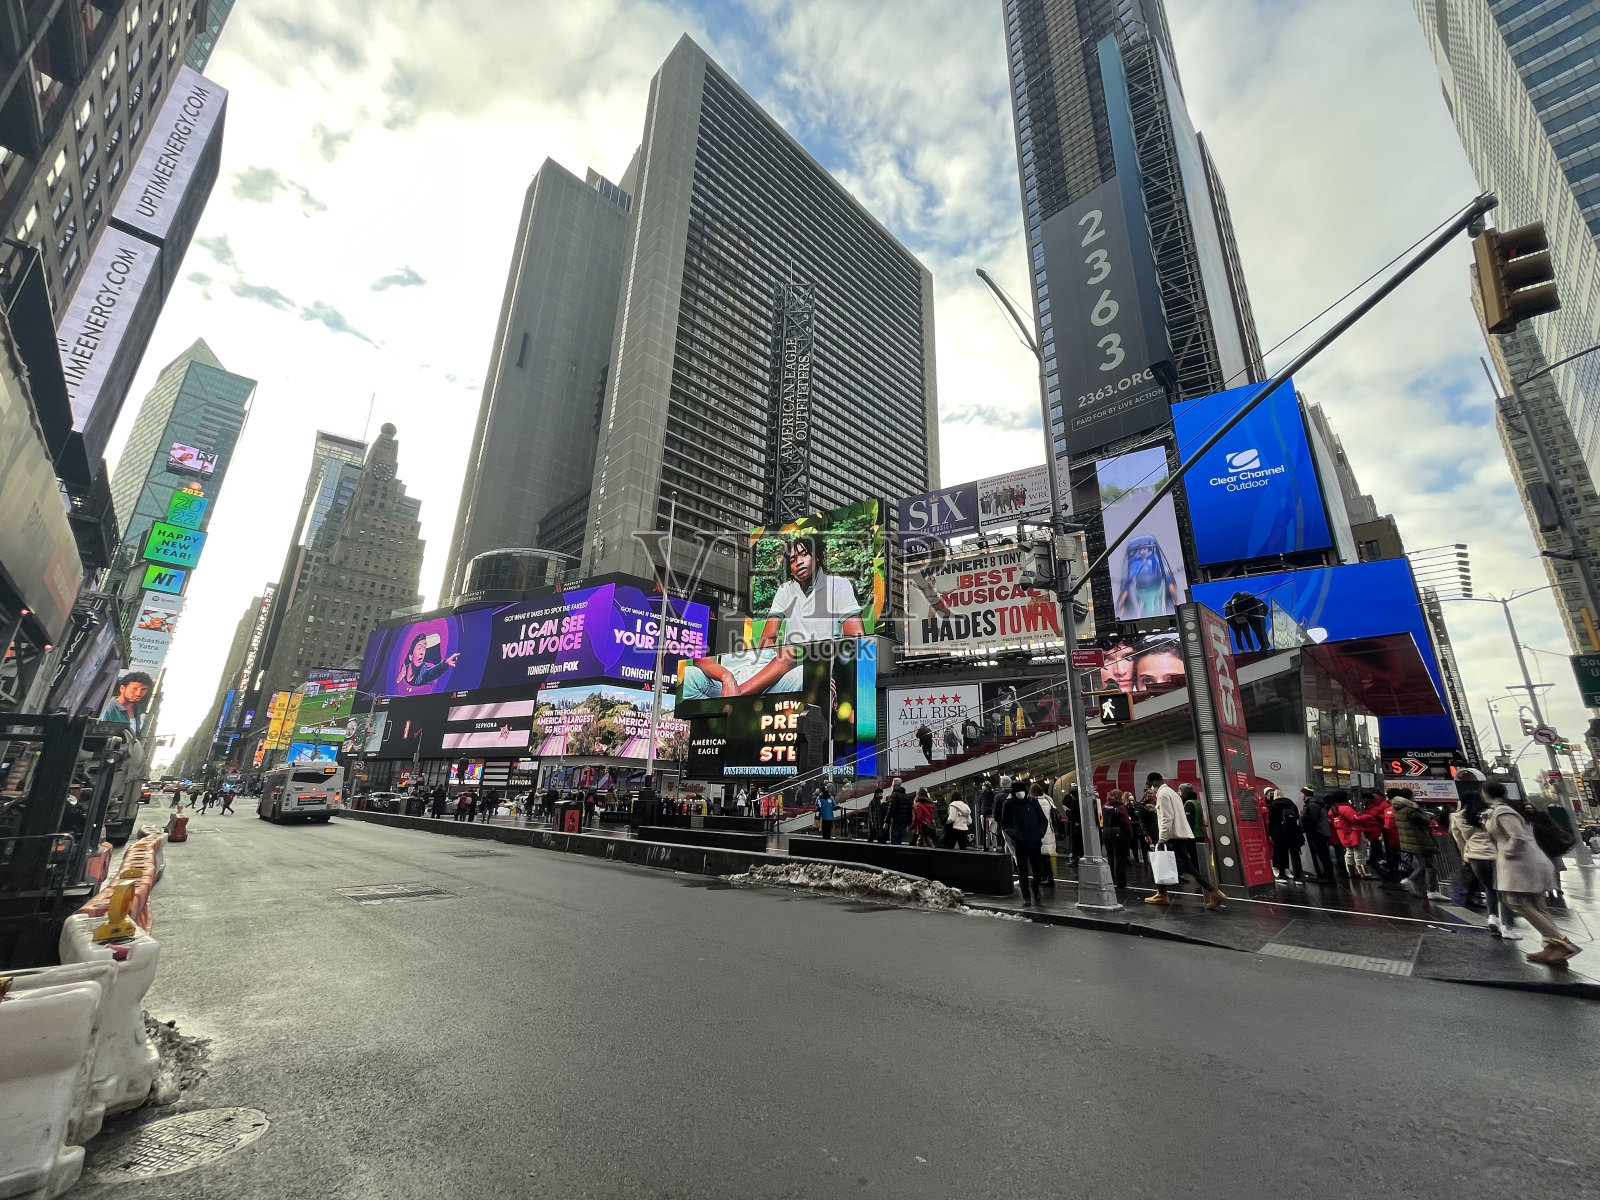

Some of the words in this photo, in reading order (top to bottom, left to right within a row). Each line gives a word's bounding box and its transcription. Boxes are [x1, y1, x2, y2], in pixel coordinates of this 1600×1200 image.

[136, 87, 210, 218] UPTIMEENERGY.COM
[784, 338, 797, 379] EAGLE
[796, 355, 810, 441] OUTFITTERS
[1076, 416, 1092, 426] PAID
[1093, 410, 1107, 420] FOR
[1108, 406, 1117, 414] BY
[1118, 401, 1133, 410] LIVE
[1134, 388, 1164, 404] ACTION
[781, 383, 795, 460] AMERICAN
[1210, 474, 1238, 486] Clear
[1239, 464, 1285, 481] Channel
[182, 487, 204, 497] 2022
[1226, 478, 1269, 492] Outdoor
[157, 529, 200, 544] HAPPY
[161, 539, 190, 551] NEW
[155, 546, 192, 560] YEAR!
[920, 557, 988, 578] WINNER!
[990, 556, 996, 568] 8
[999, 552, 1022, 566] TONY
[152, 572, 177, 587] NT
[959, 566, 1017, 589] BEST
[504, 615, 514, 623] GOT
[514, 613, 526, 621] WHAT
[531, 610, 544, 618] TAKES
[550, 606, 562, 614] SPOT
[632, 608, 645, 616] WHAT
[520, 624, 526, 640] I
[528, 619, 559, 638] CAN
[561, 614, 585, 633] SEE
[922, 602, 1058, 644] HADESTOWN
[614, 628, 655, 649] YOUR
[636, 619, 642, 633] I
[681, 629, 704, 646] SEE
[138, 643, 159, 651] Yatra
[502, 641, 536, 659] YOUR
[538, 632, 584, 655] VOICE
[527, 663, 550, 676] TONIGHT
[550, 662, 562, 675] 8pm
[563, 660, 579, 672] FOX
[621, 665, 654, 681] TONIGHT
[1209, 623, 1237, 728] tkts
[620, 709, 636, 717] OWN
[774, 700, 801, 711] NEW
[898, 708, 928, 720] ALL
[931, 705, 968, 719] RISE
[537, 716, 567, 726] AMERICA'S
[568, 715, 595, 724] LARGEST
[656, 722, 688, 732] LARGEST
[544, 726, 553, 734] 5G
[553, 725, 583, 733] NETWORK
[625, 727, 636, 736] 5G
[691, 739, 727, 747] AMERICAN
[764, 733, 776, 743] IN
[723, 766, 767, 775] AMERICAN
[768, 766, 798, 775] EAGLE
